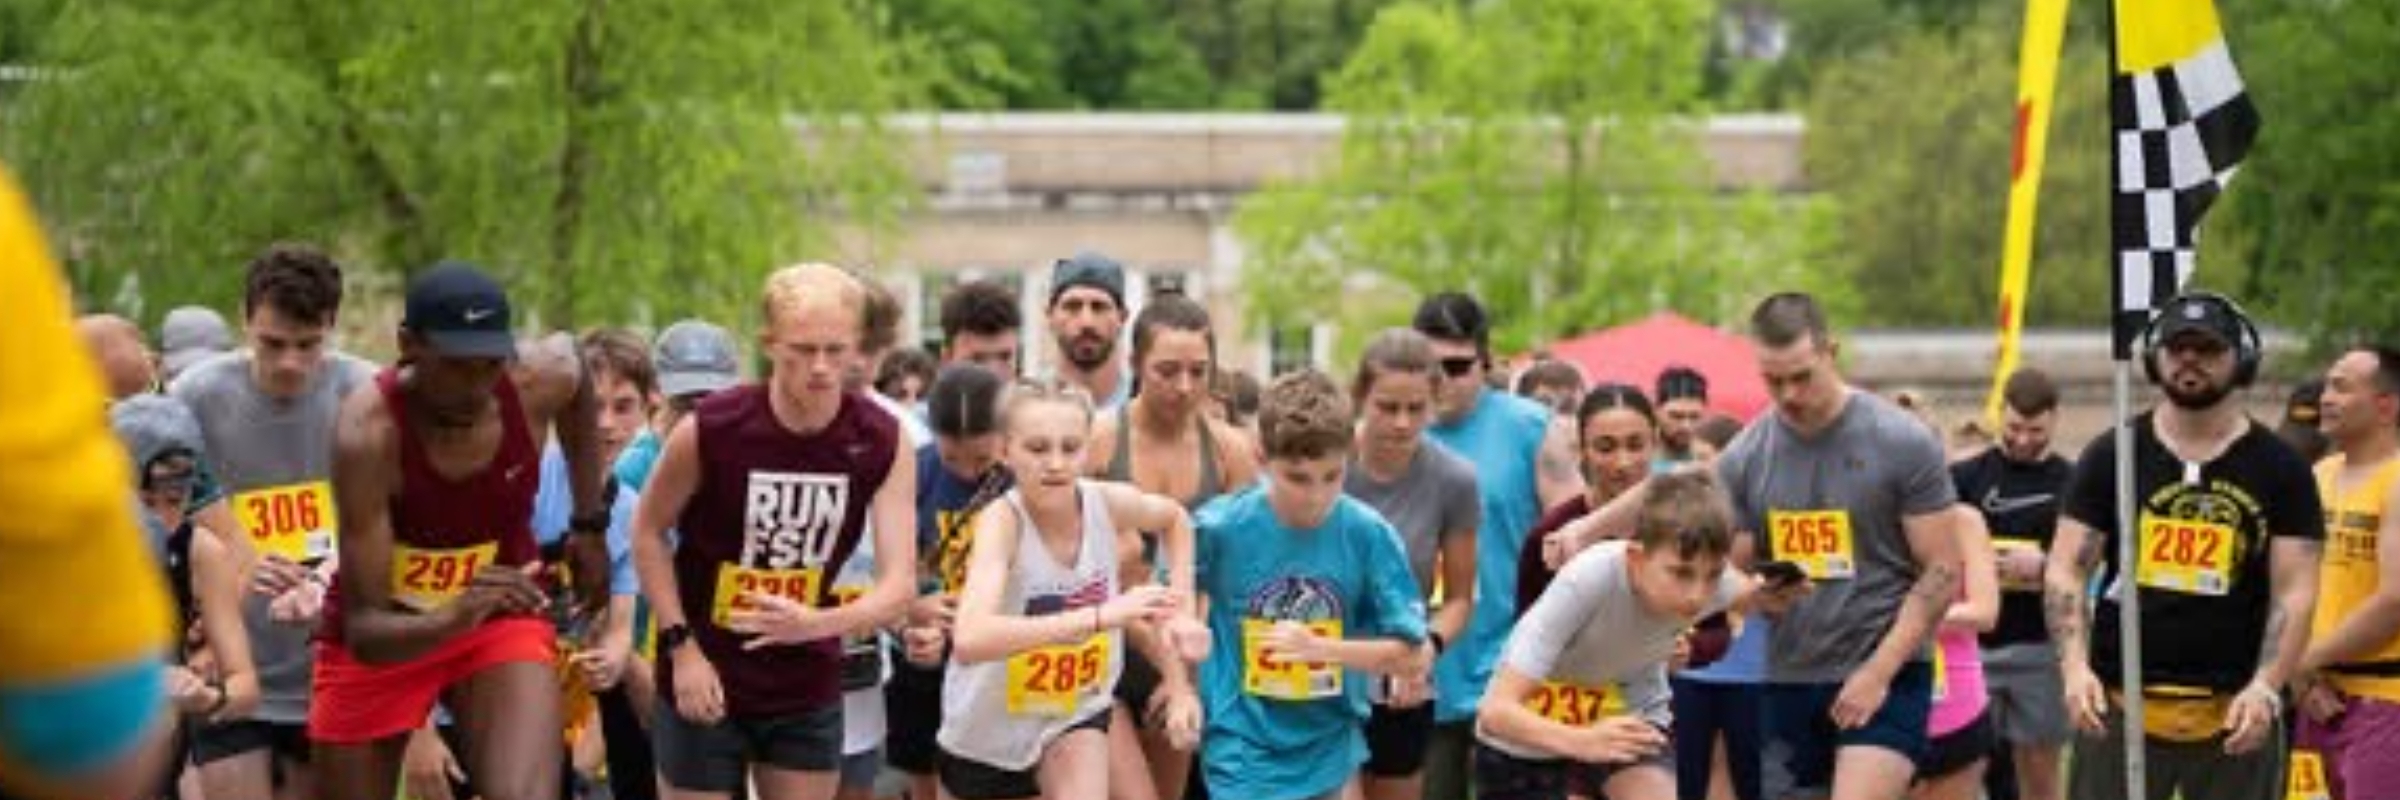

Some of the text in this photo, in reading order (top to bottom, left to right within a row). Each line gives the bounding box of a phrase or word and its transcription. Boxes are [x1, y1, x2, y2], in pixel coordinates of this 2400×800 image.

[247, 489, 320, 539] 306
[747, 481, 848, 529] RUN
[741, 527, 838, 567] FSU
[1780, 518, 1837, 553] 265
[2151, 523, 2221, 569] 282
[405, 552, 477, 591] 291
[1025, 645, 1099, 692] 285
